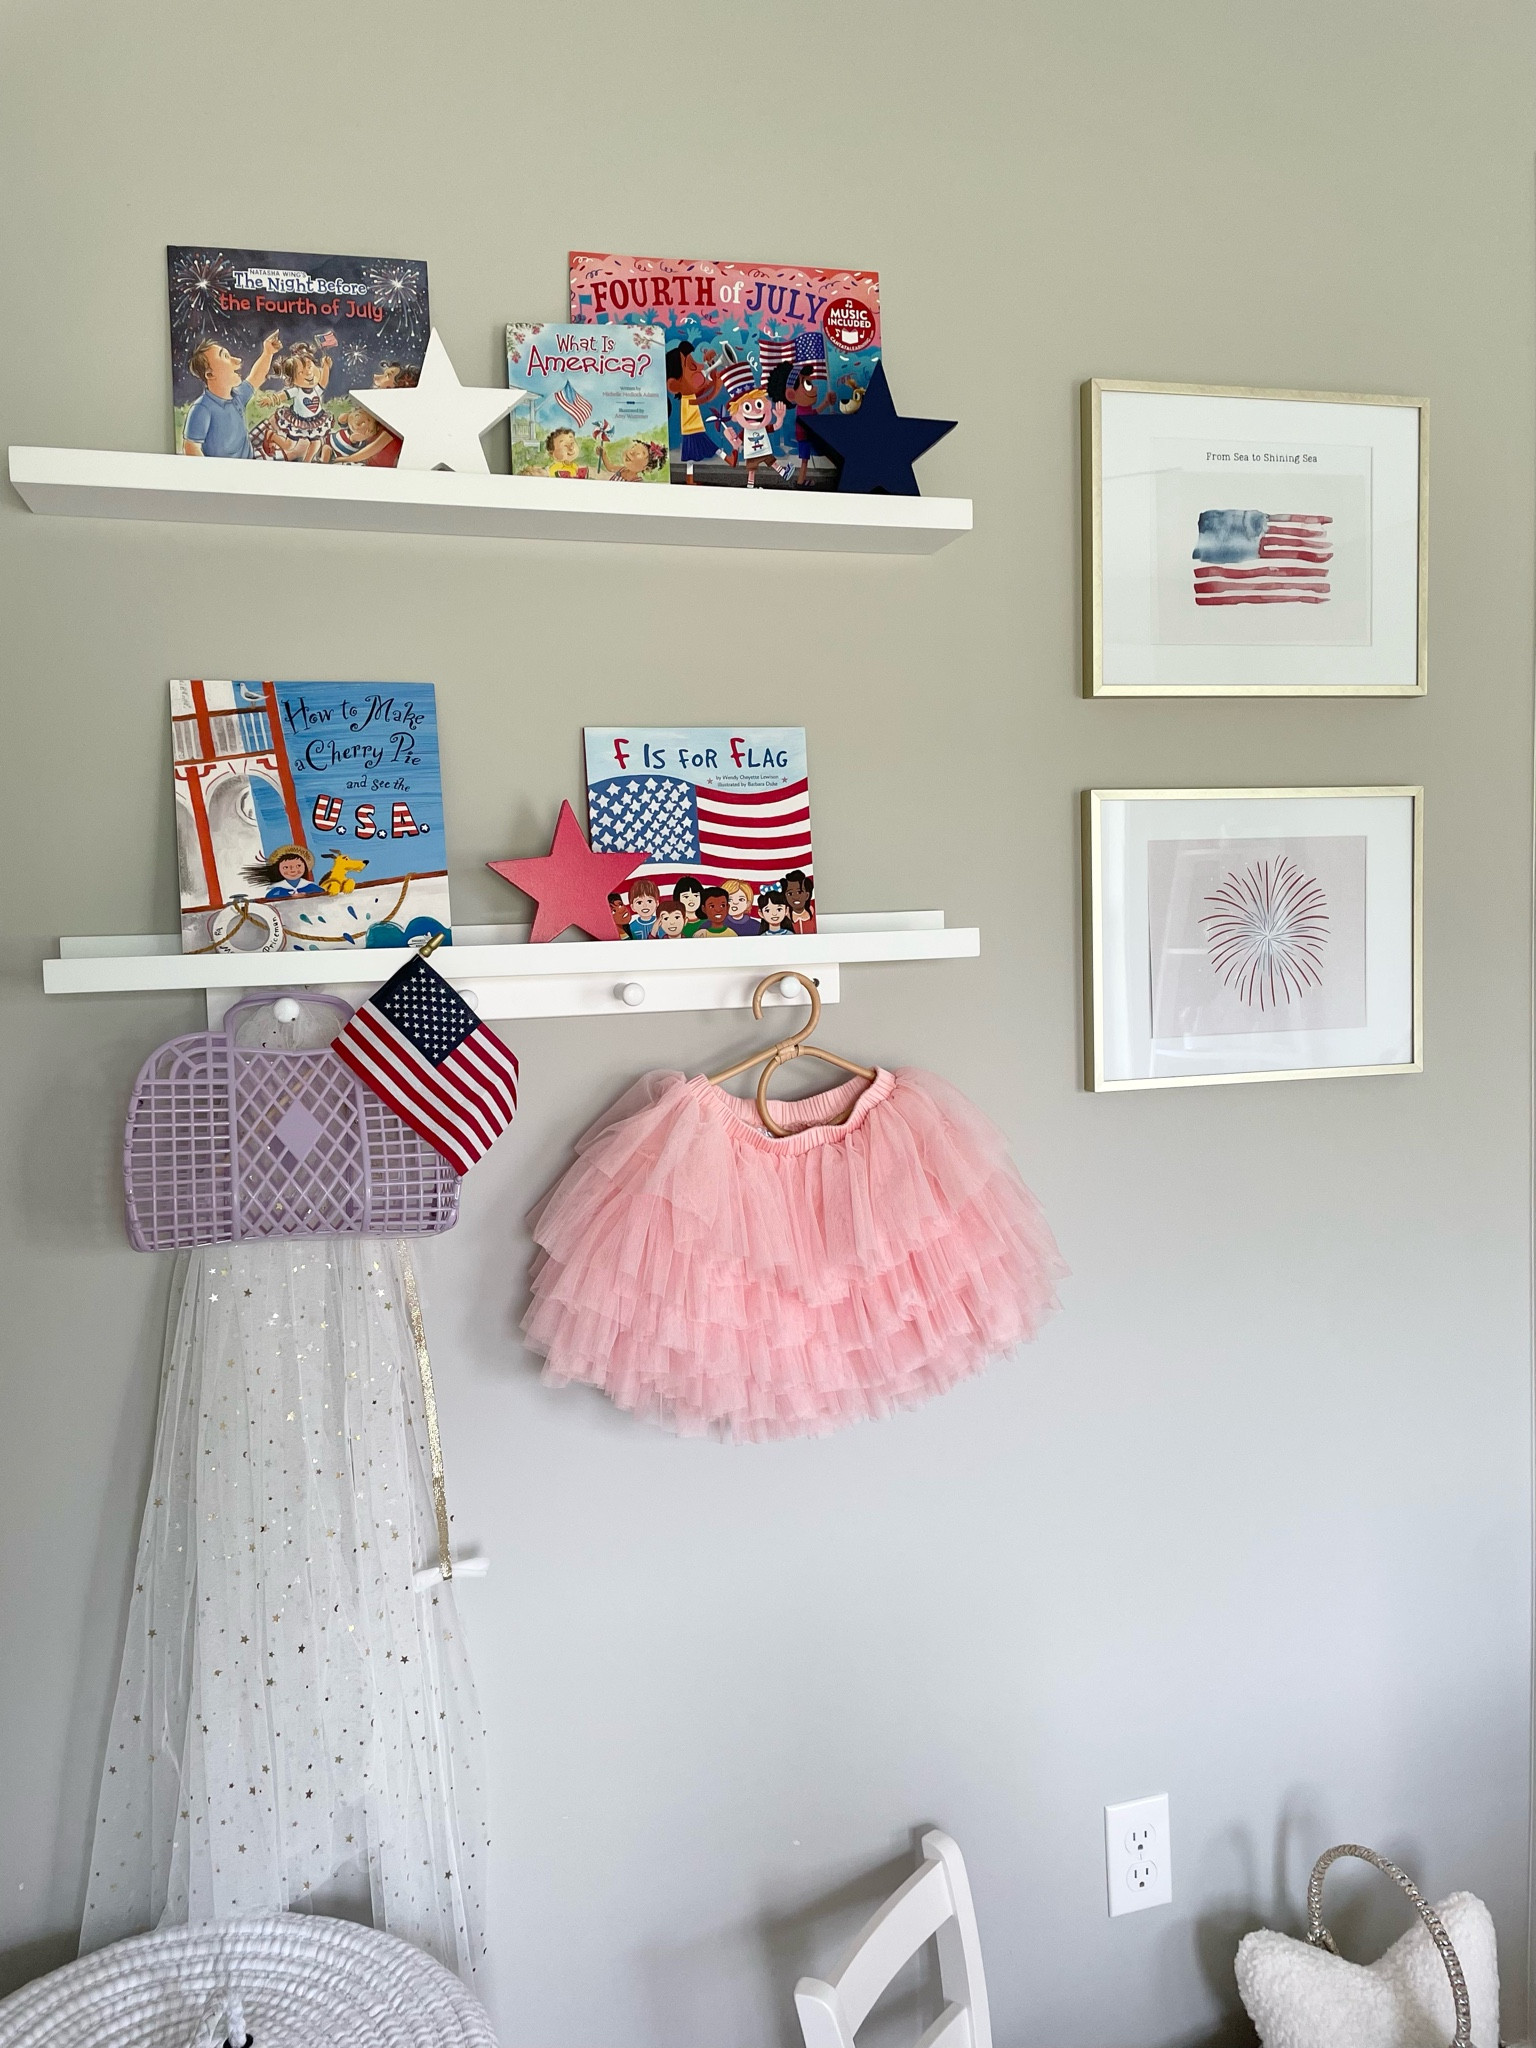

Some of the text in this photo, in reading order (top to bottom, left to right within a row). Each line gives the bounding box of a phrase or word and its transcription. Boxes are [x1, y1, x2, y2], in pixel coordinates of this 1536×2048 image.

[234, 271, 367, 294] The Night Before
[219, 292, 383, 322] the Fourth of July
[590, 276, 828, 324] FOURTH of JULY
[827, 307, 871, 328] MUSIC INCLUDED
[556, 333, 615, 353] What Is
[526, 345, 651, 378] America?
[1206, 452, 1318, 464] From Sea to Shining Sea
[281, 694, 425, 735] How to Make
[294, 731, 422, 772] a Cherry Pie
[613, 738, 630, 770] F
[730, 737, 788, 769] FLAG
[346, 774, 411, 793] and see the
[312, 793, 431, 839] U.S.A.
[262, 916, 280, 953] Priceman
